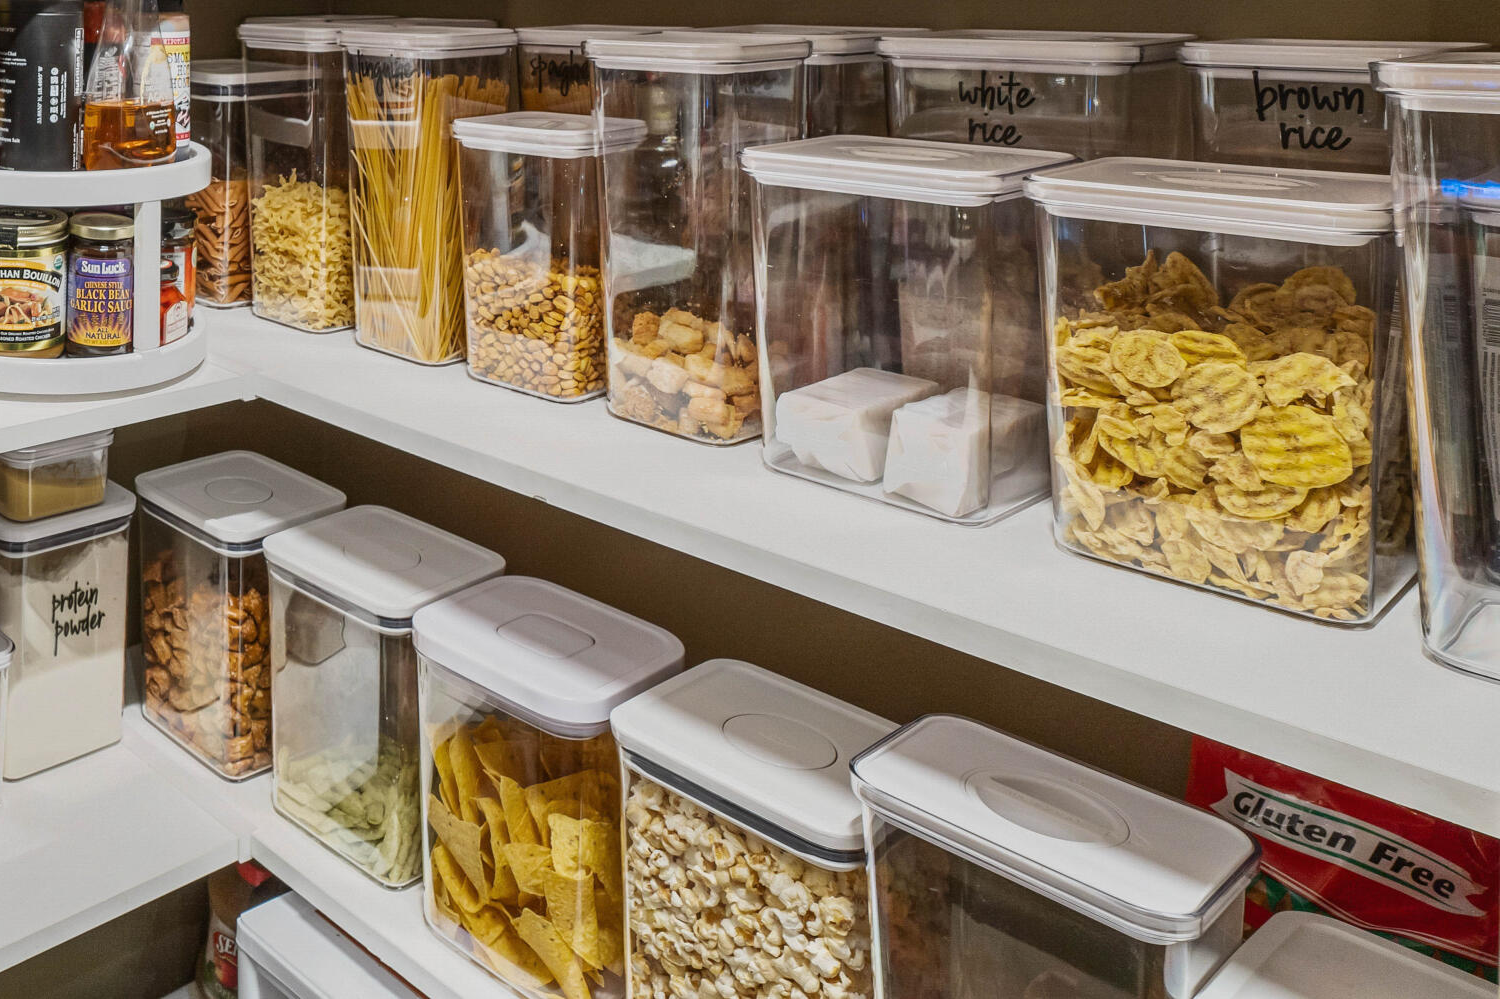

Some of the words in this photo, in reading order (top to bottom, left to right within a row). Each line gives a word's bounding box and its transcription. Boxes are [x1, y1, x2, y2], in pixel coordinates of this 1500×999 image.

[957, 70, 1036, 116] white
[1252, 70, 1365, 122] brown
[968, 110, 1023, 146] rice
[1280, 113, 1353, 151] rice
[23, 270, 62, 288] BOUILLON
[81, 261, 100, 273] Sun
[102, 261, 125, 273] Luck
[84, 281, 106, 289] CHINESE
[70, 300, 105, 313] GARLIC
[76, 288, 106, 300] BLACK
[108, 289, 130, 301] BEAN
[85, 331, 121, 340] NATURAL
[51, 583, 99, 622] protein
[53, 608, 106, 657] powder
[1232, 791, 1357, 854] Gluten
[1367, 841, 1456, 900] Free
